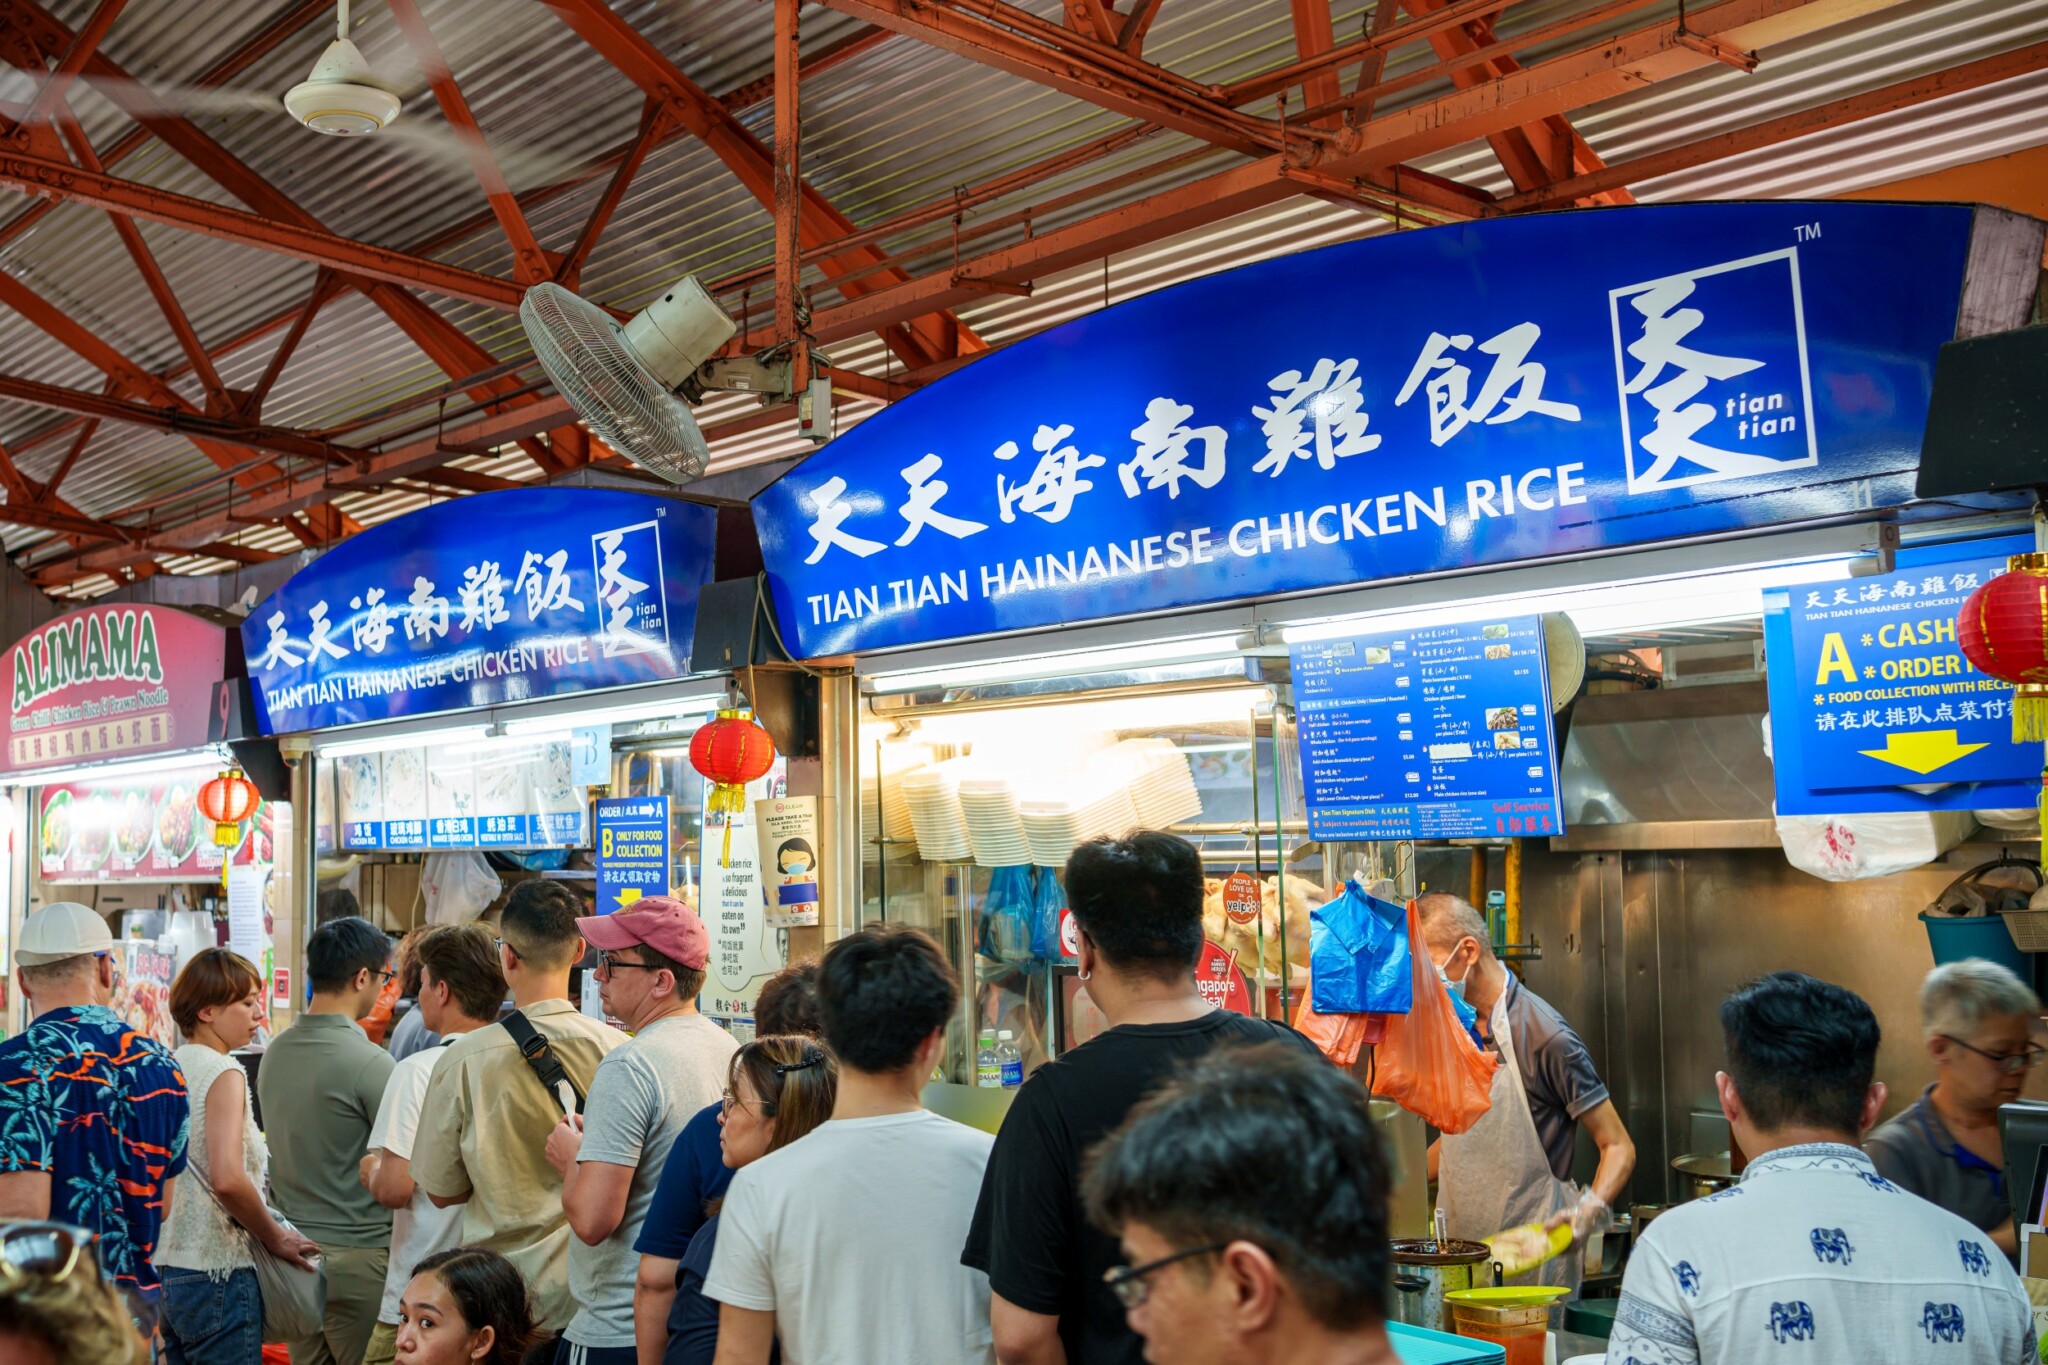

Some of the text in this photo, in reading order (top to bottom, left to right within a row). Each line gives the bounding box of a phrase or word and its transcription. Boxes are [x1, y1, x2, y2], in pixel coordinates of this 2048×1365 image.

[1794, 222, 1822, 243] TM
[1725, 391, 1783, 417] tian
[1738, 413, 1797, 439] tian
[803, 321, 1582, 566] 天天海南雞飯
[807, 463, 1586, 625] TIAN TIAN HAINANESE CHICKEN RICE
[1804, 572, 1981, 609] 天天海南雞飯
[265, 549, 585, 671] 天天海南雞飯
[636, 602, 657, 616] tian
[1805, 611, 1827, 620] TIAN
[1830, 608, 1852, 618] TIAN
[1855, 602, 1912, 615] HAINANESE
[1914, 597, 1959, 610] CHICKEN
[640, 616, 662, 630] tian
[1878, 618, 1956, 648] CASH
[12, 610, 163, 713] ALIMAMA
[1815, 632, 1858, 685] A
[1881, 655, 1960, 680] ORDER
[267, 636, 590, 712] TIAN TIAN HAINANESE CHICKEN RICE
[1828, 679, 2014, 704] FOOD COLLECTION WITH RECE
[11, 715, 30, 732] Green
[52, 705, 81, 725] Chicken
[83, 701, 100, 718] Rice
[110, 695, 137, 715] Prawn
[138, 687, 168, 706] Noodle
[219, 682, 230, 738] 9
[584, 732, 598, 766] B
[600, 806, 621, 818] ORDER
[655, 802, 664, 818] A
[1492, 801, 1549, 813] Self Service
[602, 828, 614, 858] B
[616, 830, 663, 841] ONLY FOR FOOD
[616, 844, 663, 858] COLLECTION
[743, 859, 752, 869] rice
[725, 887, 747, 897] delicious
[732, 874, 753, 885] fragrant
[1229, 885, 1254, 894] LOVE US
[1232, 878, 1250, 886] PEOPLE
[722, 912, 744, 920] eaten on
[1227, 900, 1246, 913] yelp
